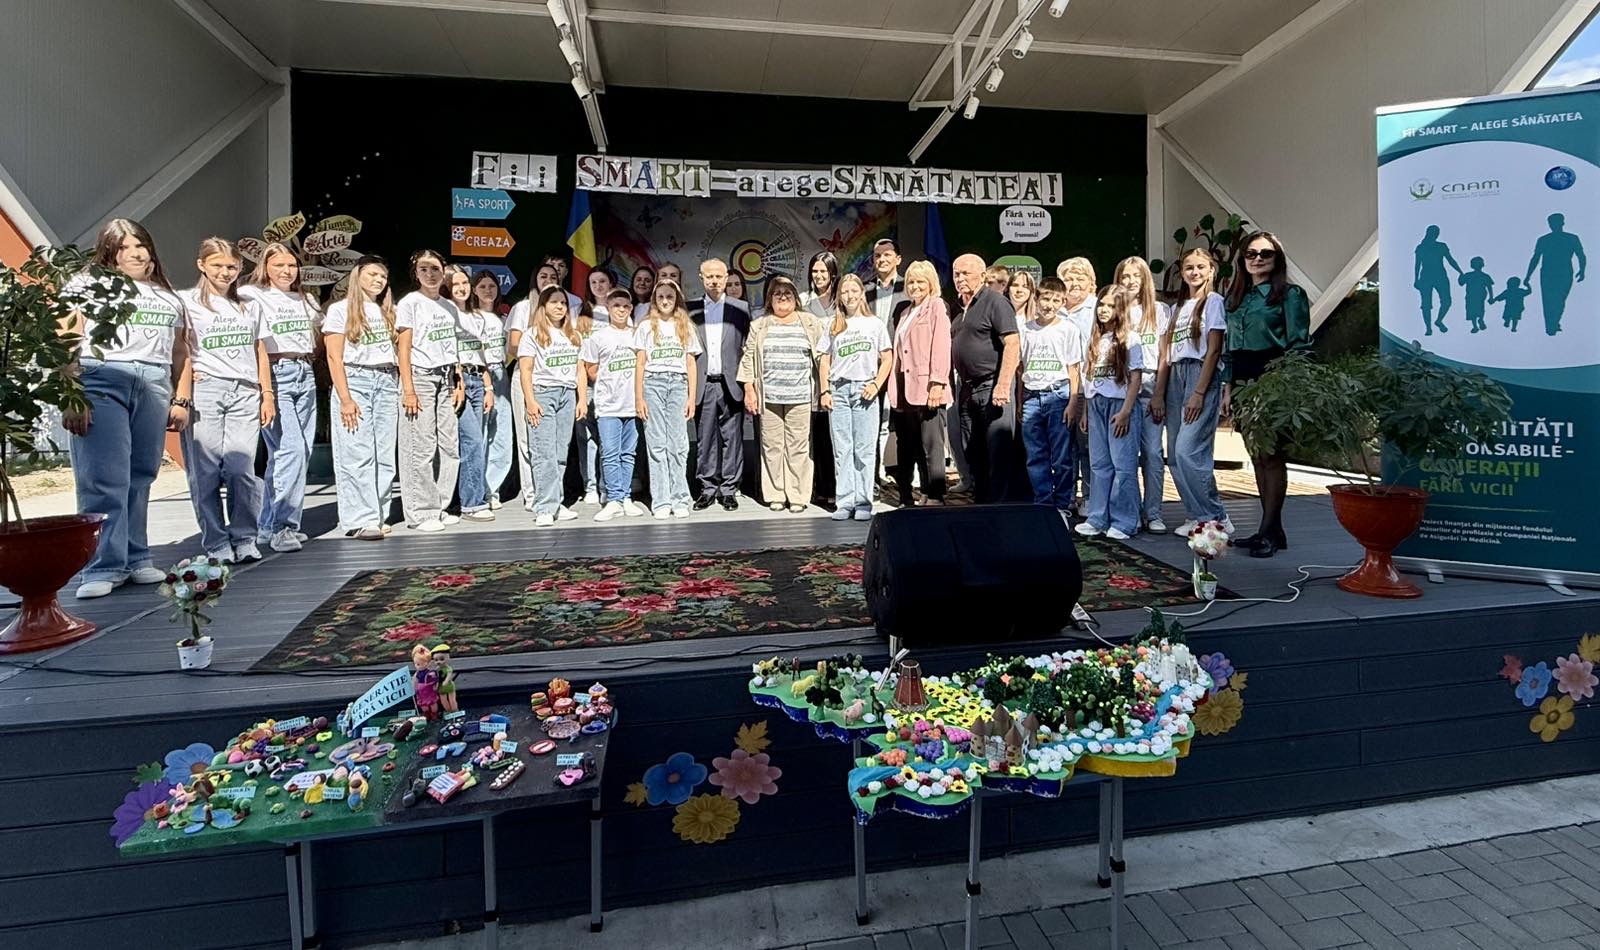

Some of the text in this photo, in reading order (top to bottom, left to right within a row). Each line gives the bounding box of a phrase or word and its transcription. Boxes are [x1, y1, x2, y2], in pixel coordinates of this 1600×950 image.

[1418, 124, 1458, 137] SMART
[1470, 120, 1508, 131] ALEGE
[1511, 112, 1583, 127] SĂNĂTATEA
[463, 198, 510, 210] FA SPORT
[315, 233, 346, 251] Artă
[206, 337, 220, 349] FII
[1470, 481, 1514, 496] VICII
[1503, 532, 1540, 542] Companiei
[376, 687, 407, 706] VICII
